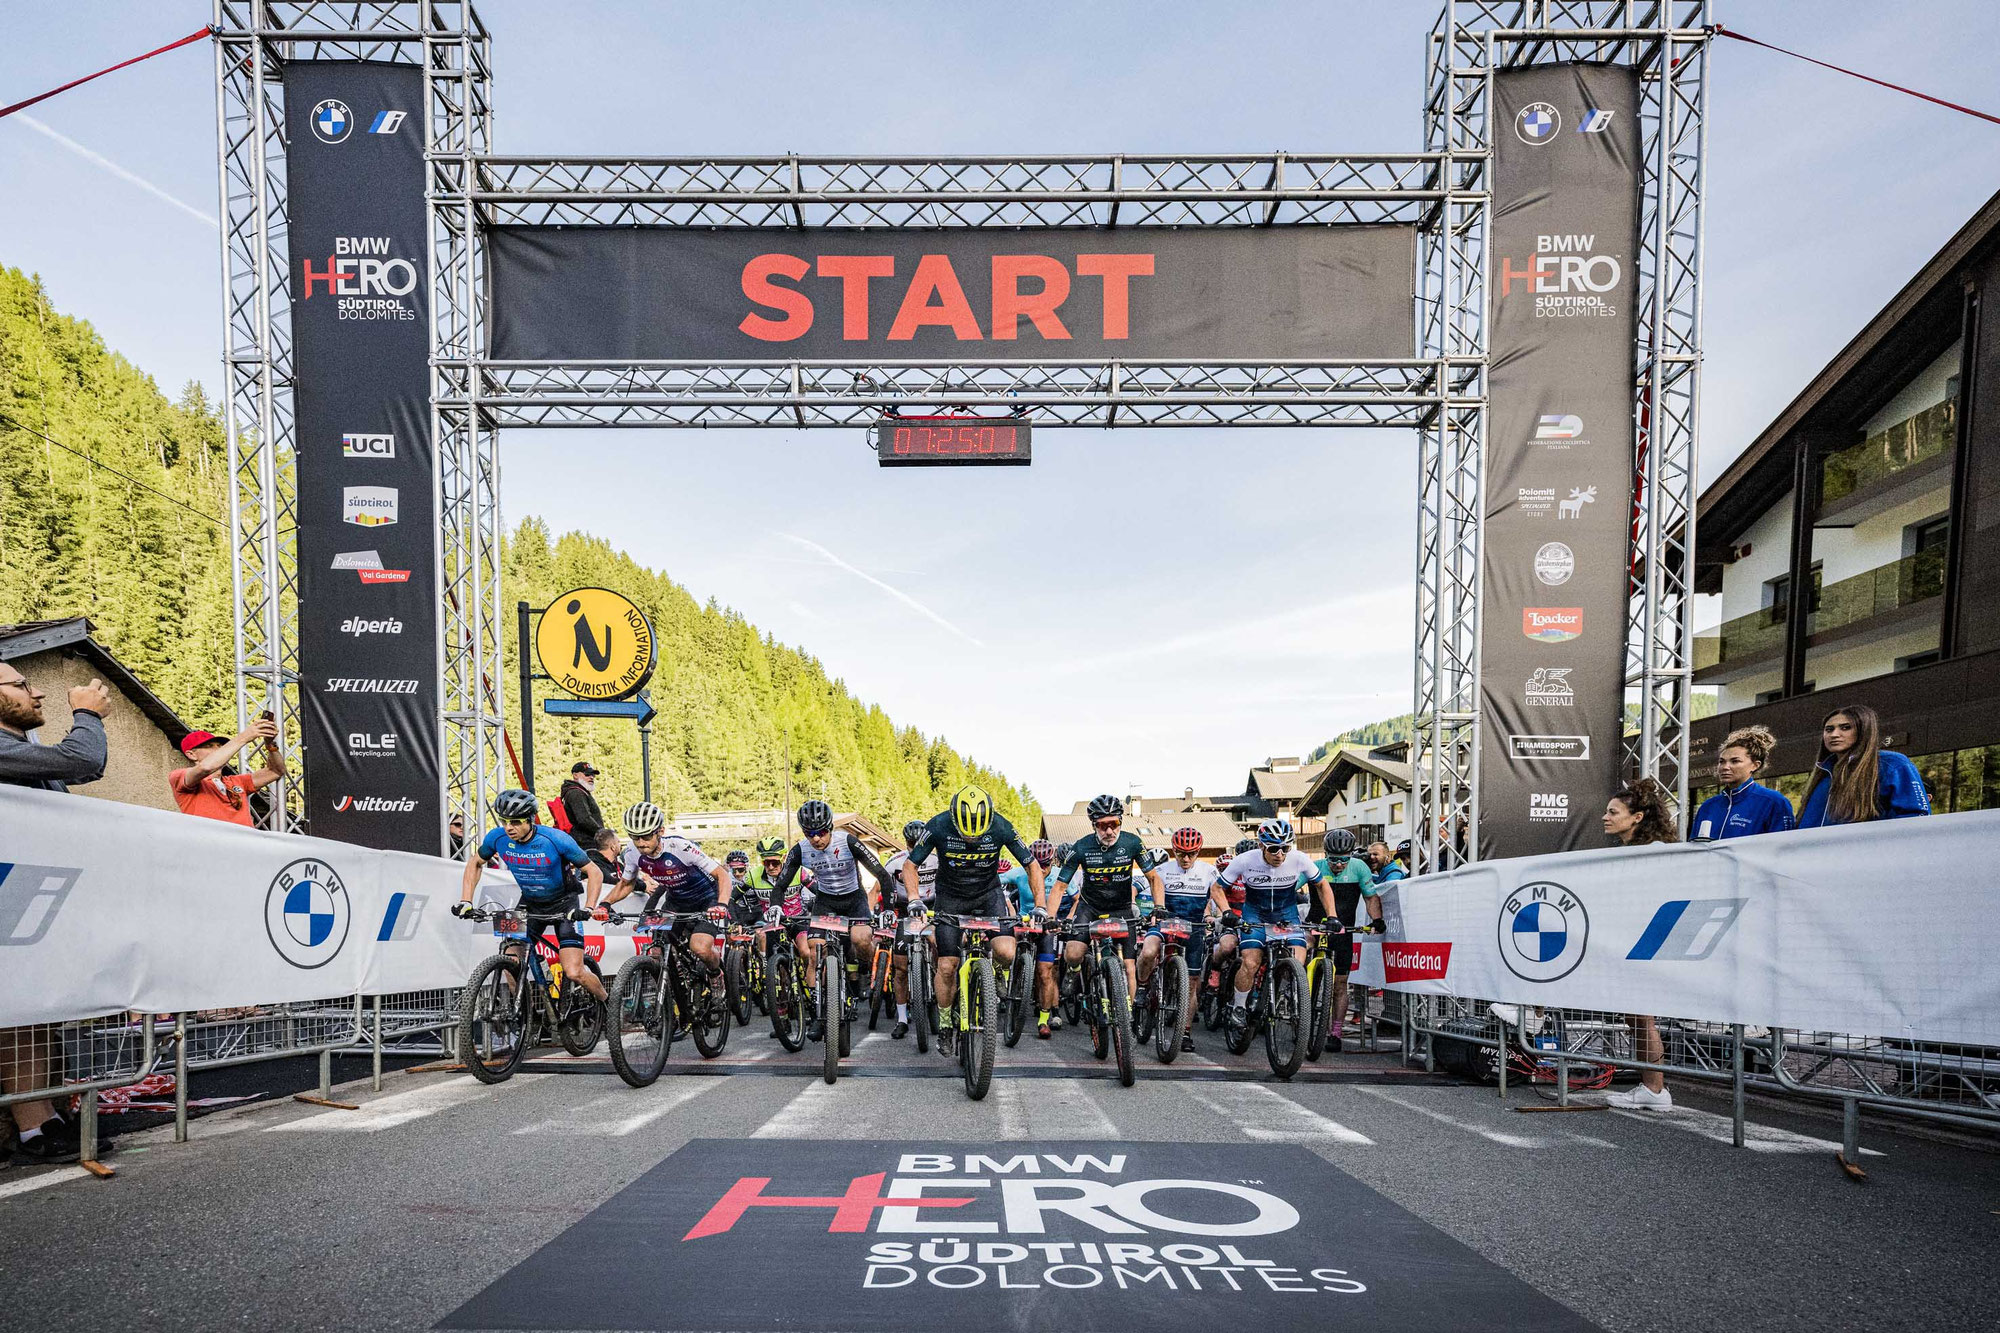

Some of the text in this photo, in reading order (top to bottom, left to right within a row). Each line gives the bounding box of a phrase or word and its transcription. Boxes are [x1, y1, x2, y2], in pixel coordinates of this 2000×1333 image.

[316, 101, 348, 115] BMW
[1521, 104, 1556, 118] BMW
[335, 237, 391, 255] BMW
[1537, 234, 1595, 253] BMW
[303, 254, 417, 300] HERO
[1502, 252, 1621, 299] HERO
[337, 297, 404, 310] SÜDTIROL
[738, 253, 1155, 342] START
[1535, 294, 1605, 307] SÜDTIROL
[338, 309, 415, 321] DOLOMITES
[1535, 307, 1617, 318] DOLOMITES
[352, 438, 391, 454] UCI
[894, 427, 1016, 454] 07:25:01
[336, 556, 380, 568] Dolomites
[375, 572, 406, 580] Gardena
[340, 615, 403, 637] alperia
[1528, 612, 1578, 626] Loacker
[561, 609, 650, 696] TOURISTIK INFORMATION
[324, 678, 420, 694] SPECIALIZED
[1525, 696, 1574, 706] GENERALI
[353, 796, 416, 812] vittoria
[1530, 793, 1569, 807] PMG
[505, 851, 546, 859] CICLOCLUB
[945, 852, 998, 860] SCOTT
[1086, 864, 1132, 874] SCOTT
[279, 863, 341, 894] BMW
[1506, 887, 1576, 915] BMW
[1385, 950, 1442, 971] Val Gardena
[1480, 1046, 1523, 1062] MYLPS
[896, 1153, 1127, 1174] BMW
[681, 1171, 1301, 1242] HERO
[865, 1238, 1277, 1267] SÜDTIROL
[862, 1264, 1367, 1294] DOLOMITES
